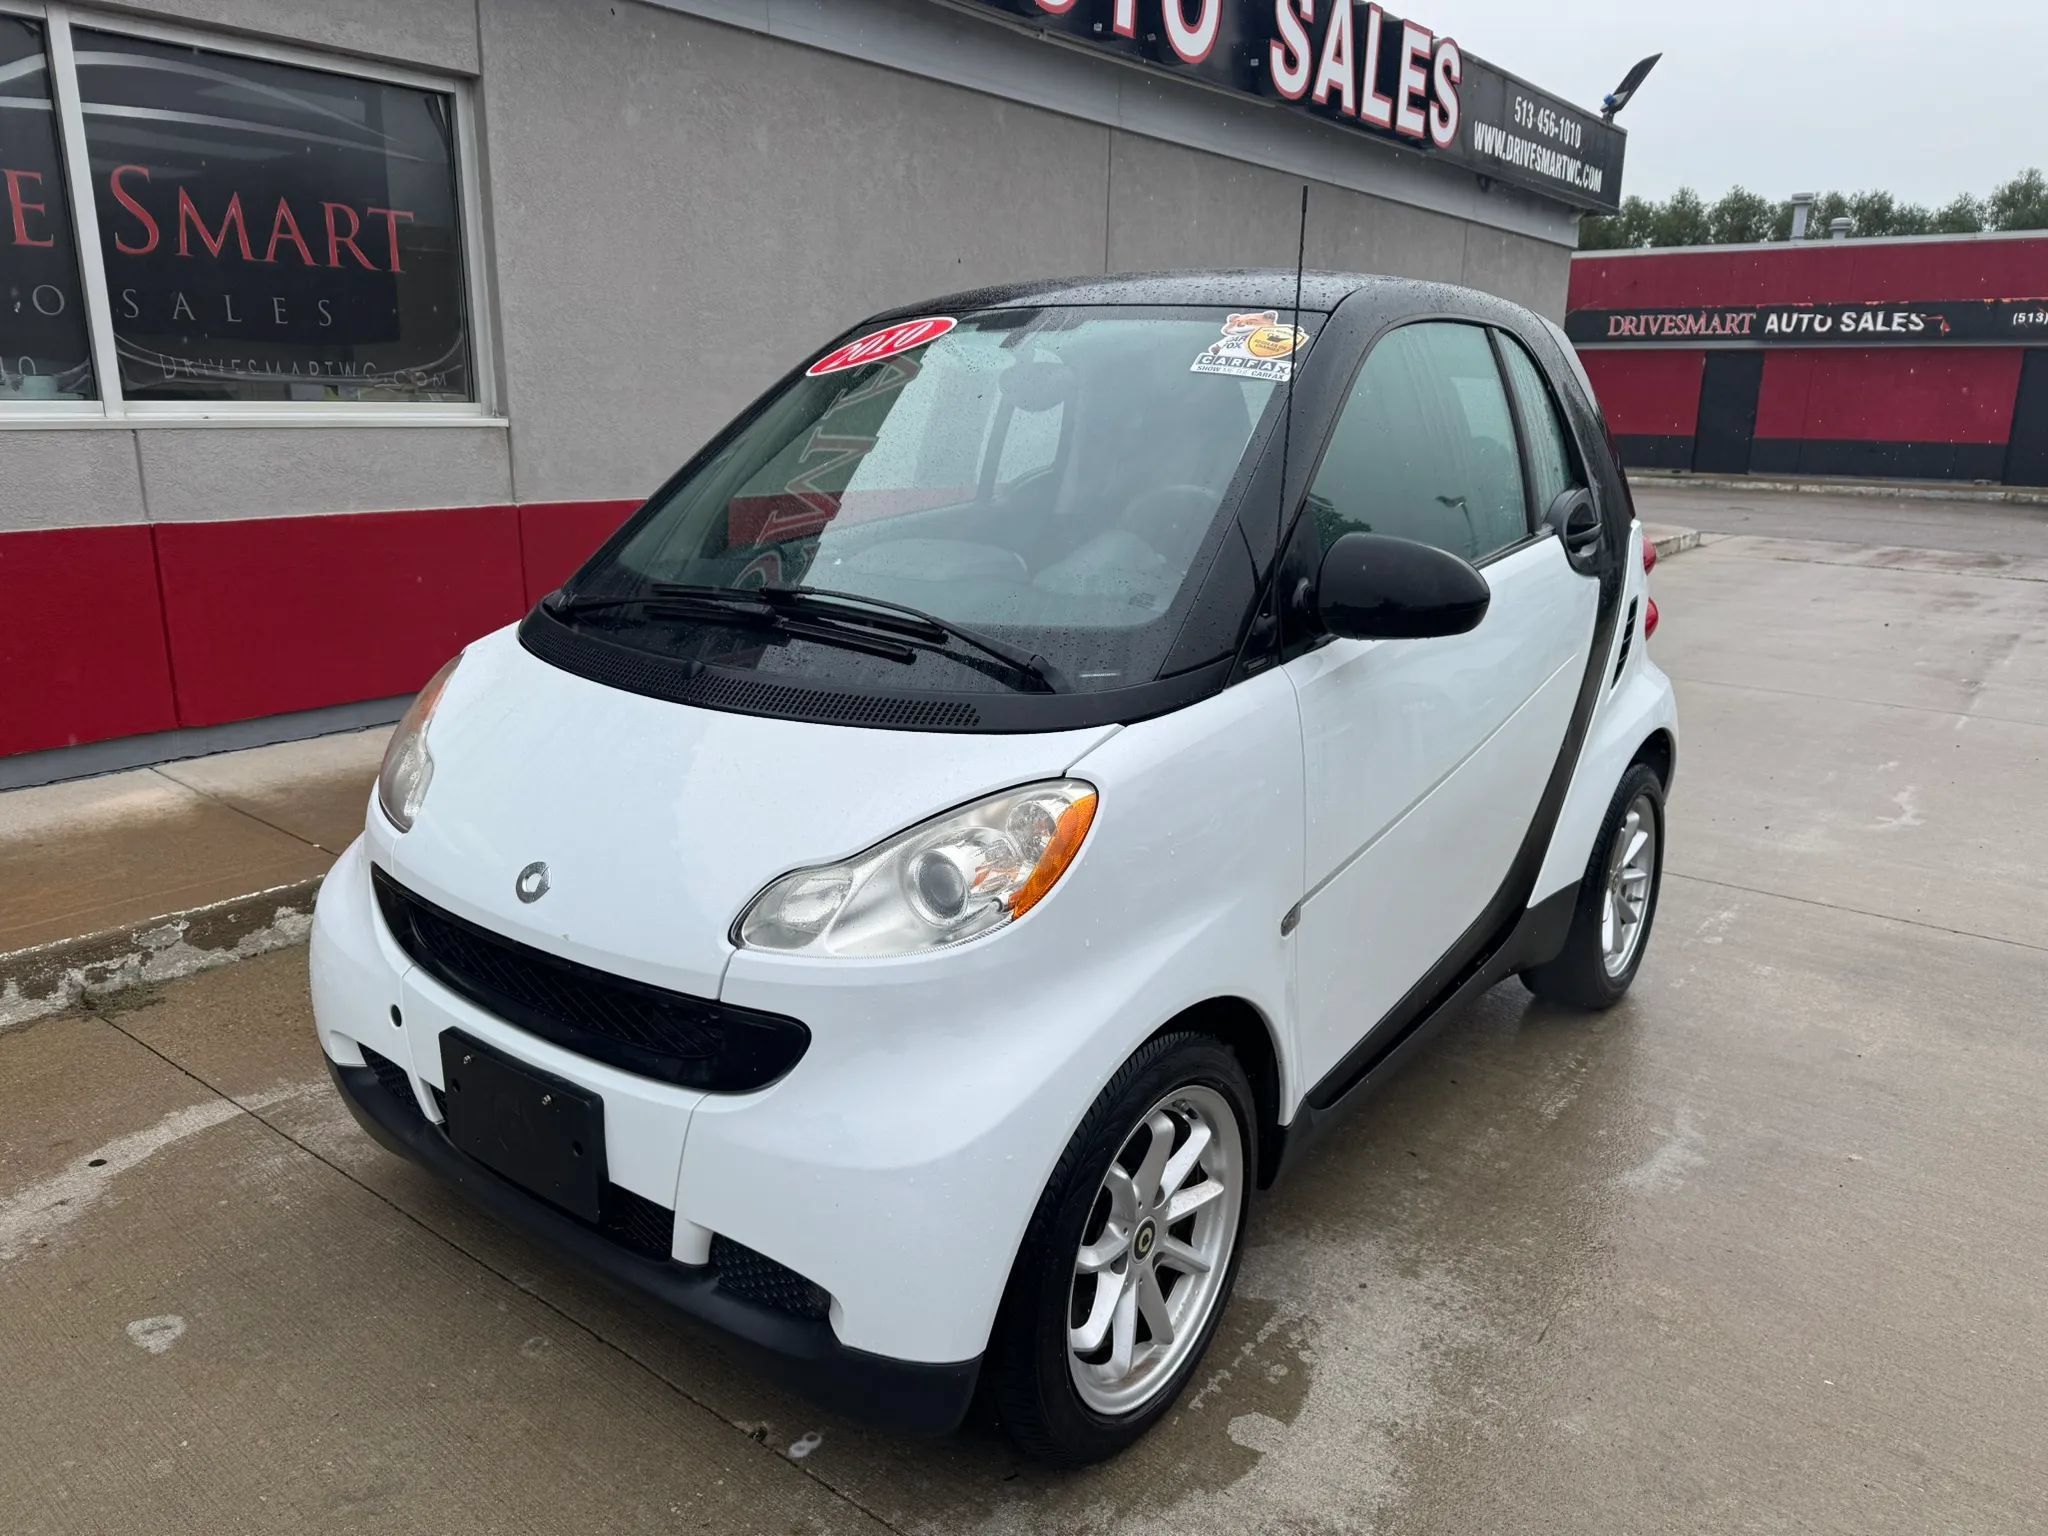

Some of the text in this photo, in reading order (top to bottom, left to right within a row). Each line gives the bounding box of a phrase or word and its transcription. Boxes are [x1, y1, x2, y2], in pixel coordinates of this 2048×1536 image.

[1270, 0, 1463, 149] SALES
[1514, 96, 1582, 149] 513-456-1010
[1473, 120, 1603, 193] WWW.DRIVESMARTWC.COM
[110, 164, 415, 274] SMART
[122, 288, 333, 327] SALES
[1607, 311, 1926, 337] DRIVESMART AUTO SALES
[1200, 355, 1289, 374] CARFAX
